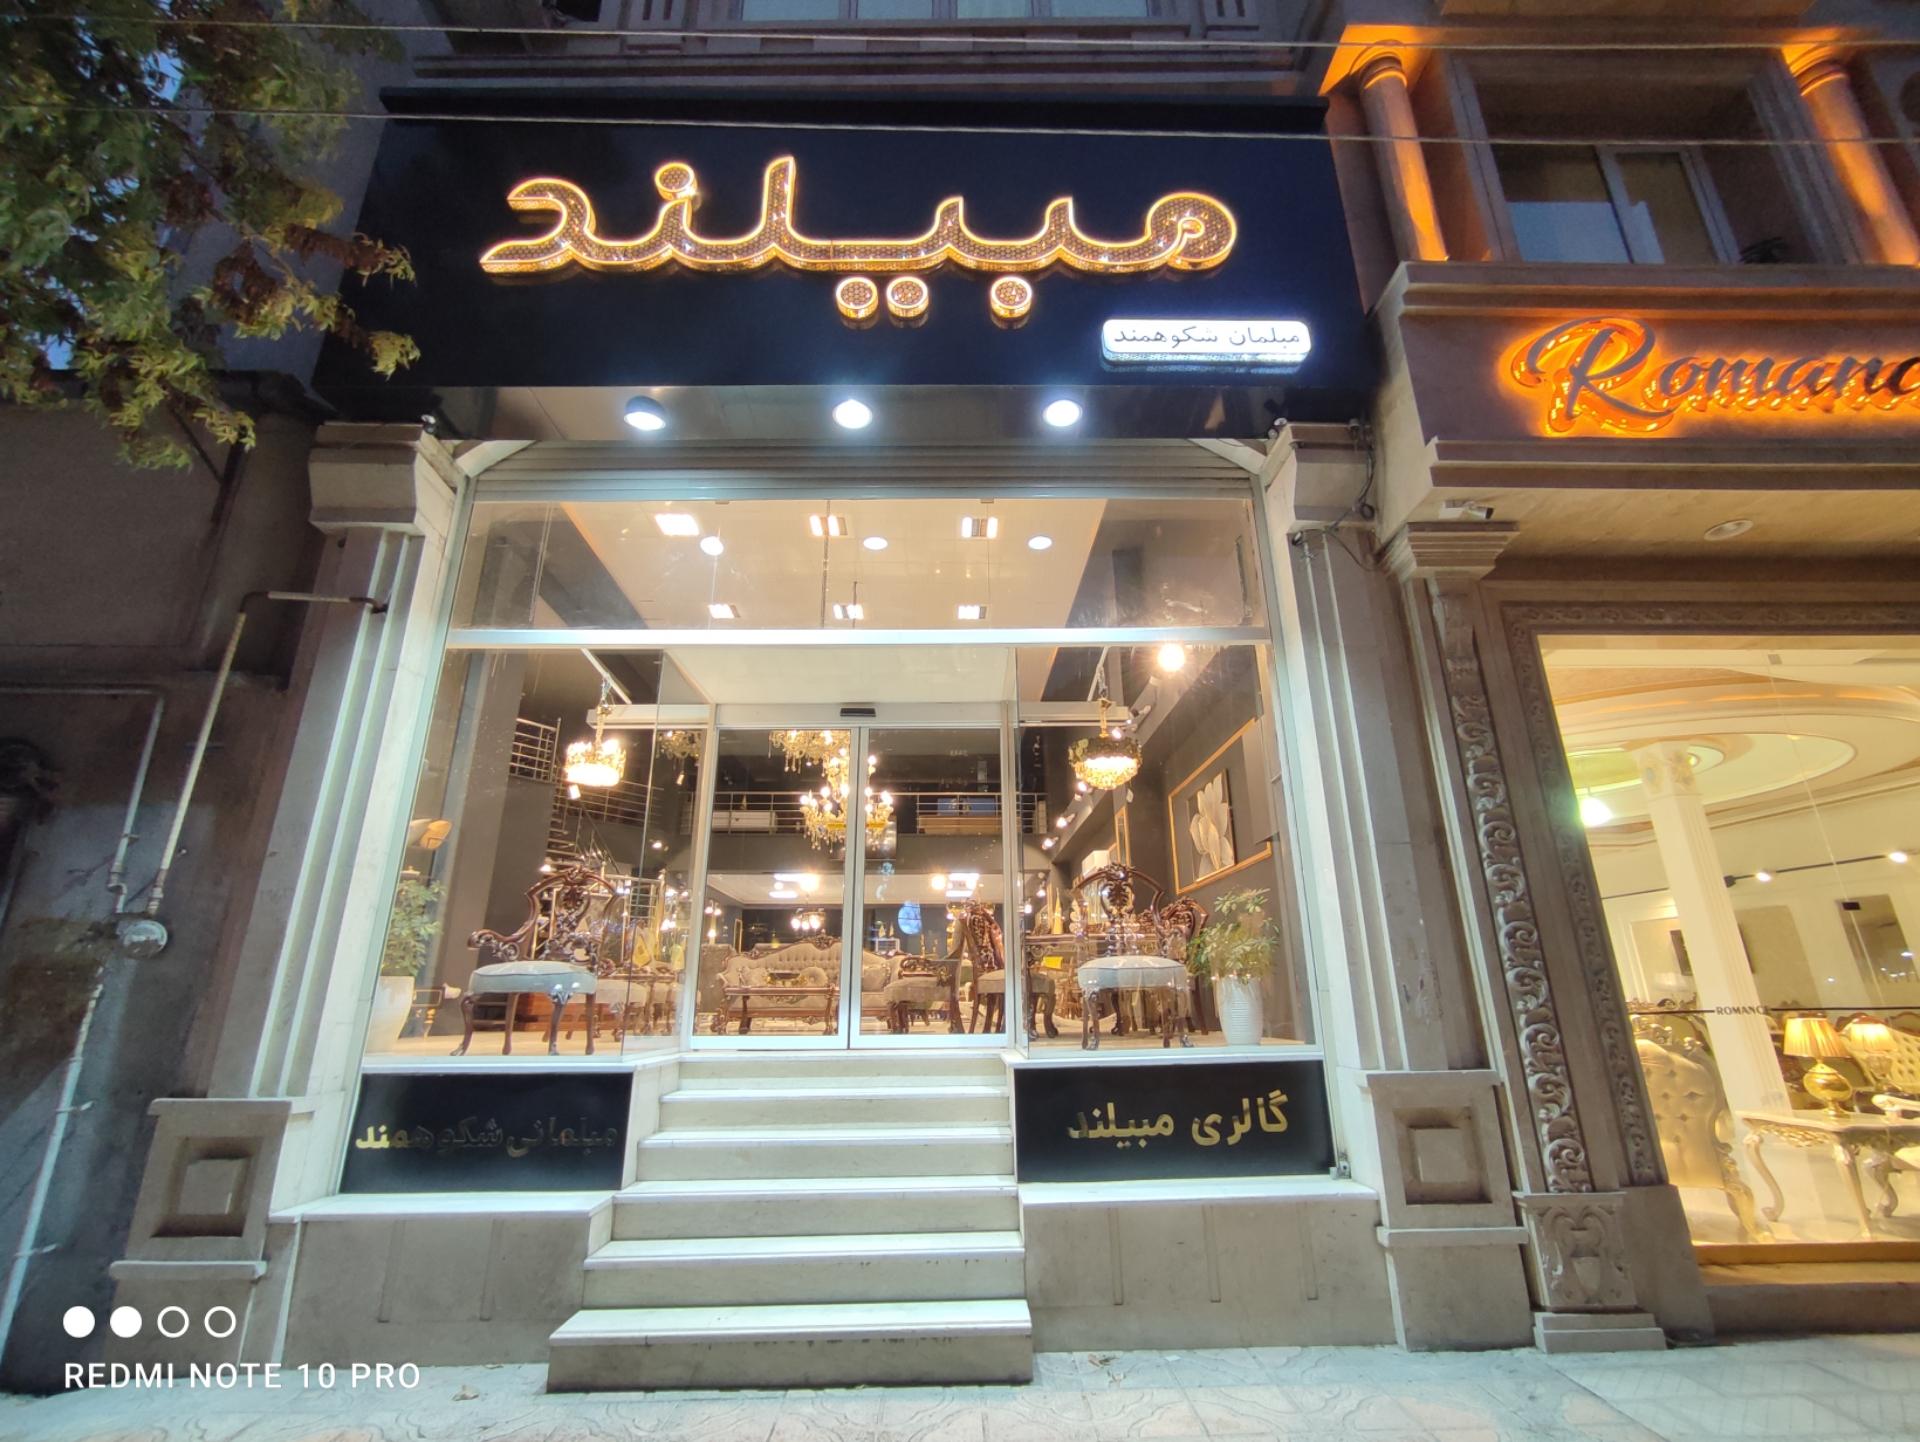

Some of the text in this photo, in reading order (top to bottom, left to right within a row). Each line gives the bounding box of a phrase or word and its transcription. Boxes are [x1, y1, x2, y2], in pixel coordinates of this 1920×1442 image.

[1114, 326, 1300, 349] مبلمان شکوهمند
[1066, 1089, 1289, 1148] گالری مبیلند
